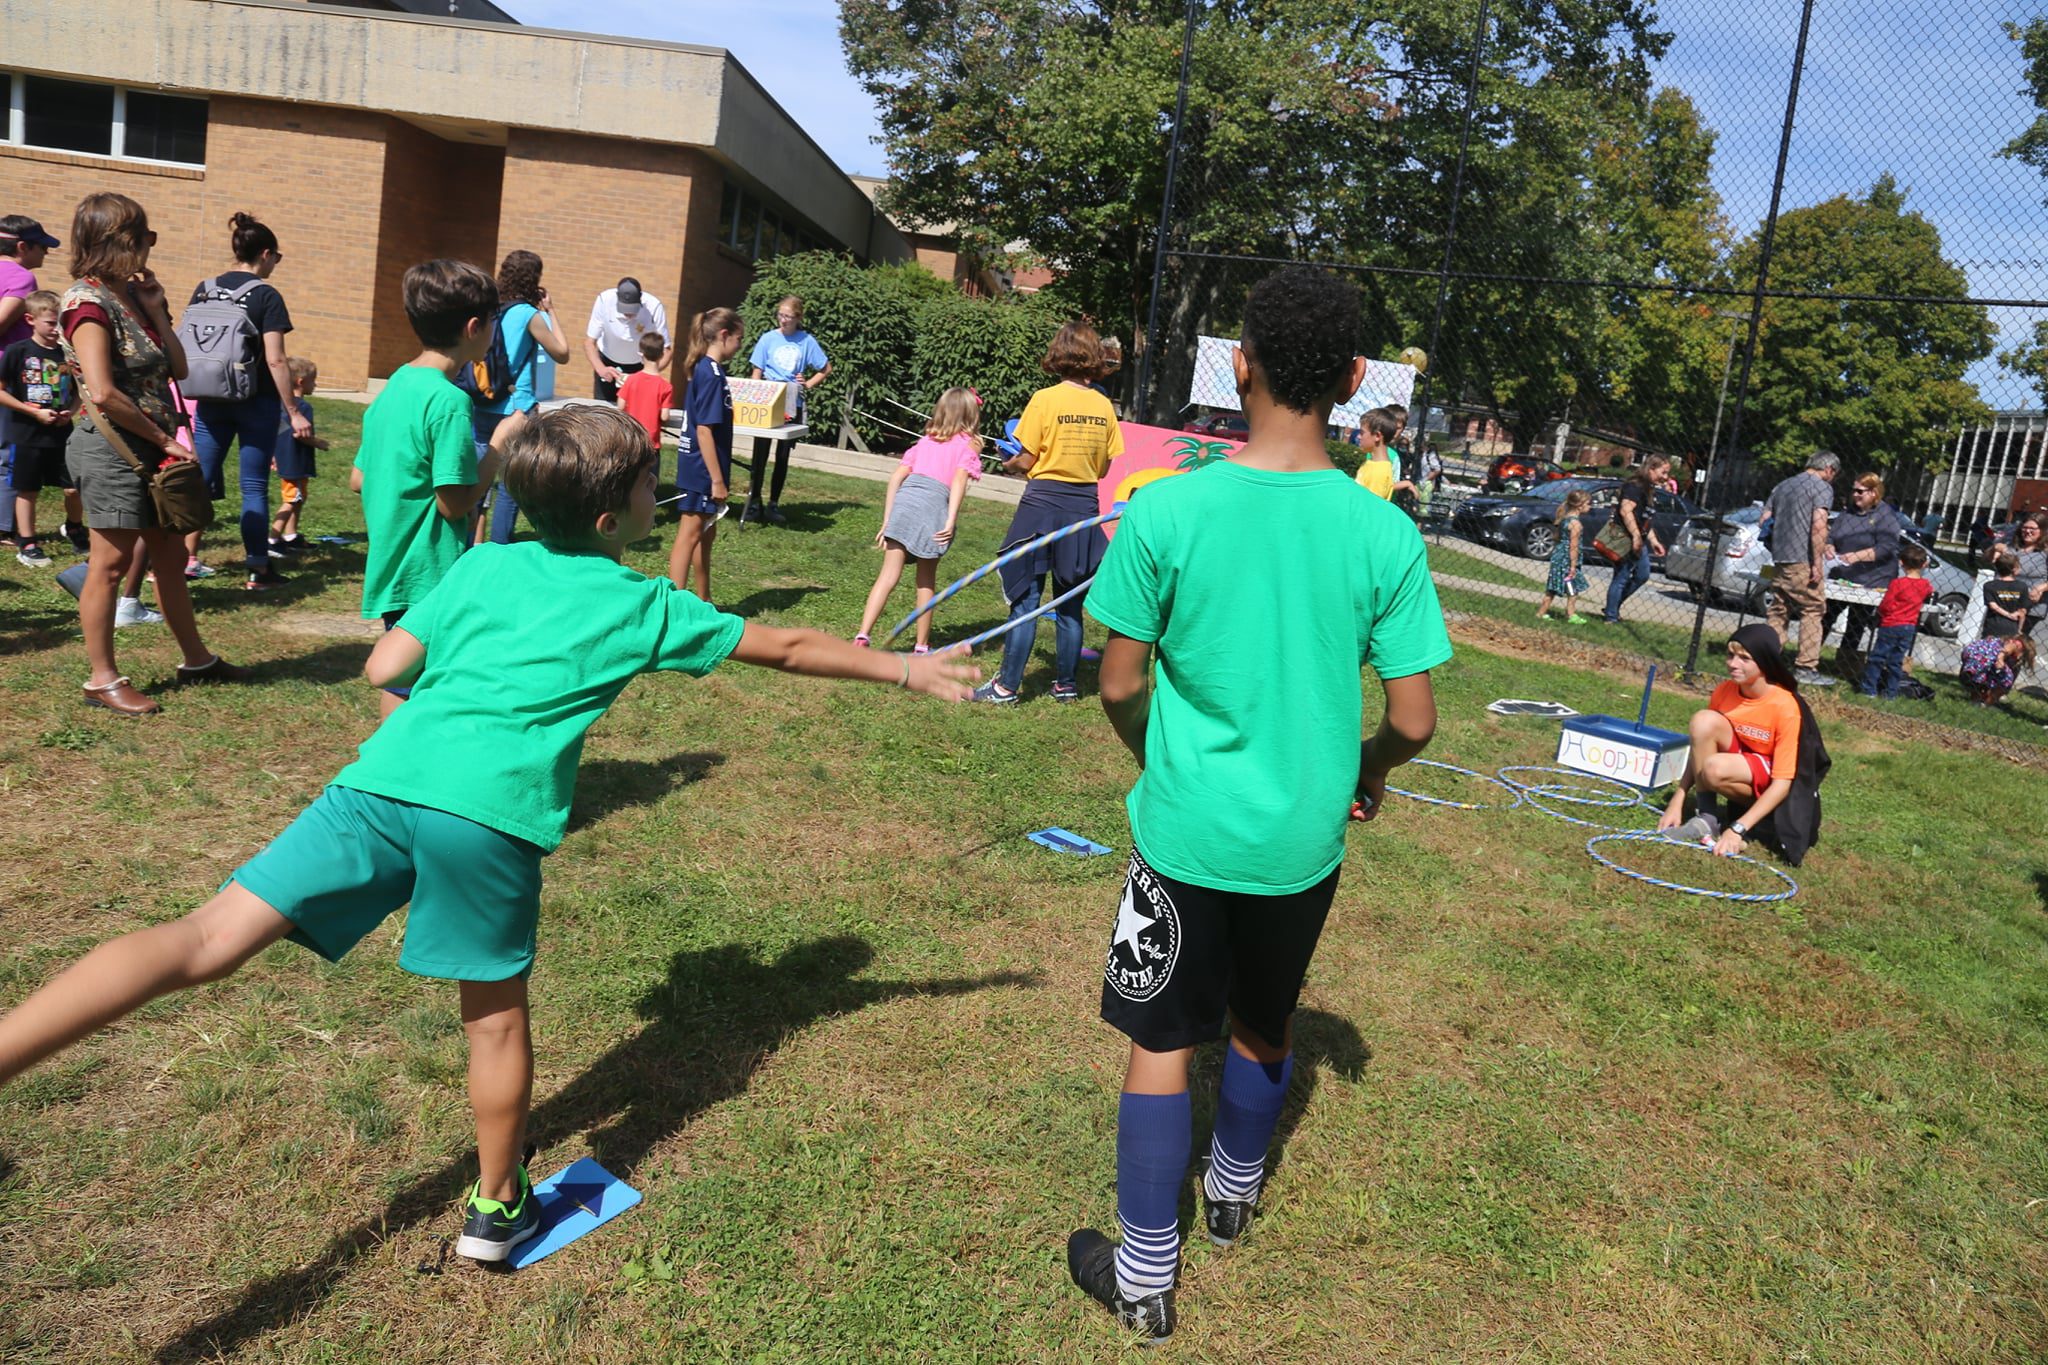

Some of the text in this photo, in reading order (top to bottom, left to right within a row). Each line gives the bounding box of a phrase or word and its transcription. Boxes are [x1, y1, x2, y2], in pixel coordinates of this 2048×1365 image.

[740, 406, 768, 425] POP
[1057, 414, 1108, 427] VOLUNTEE
[1735, 724, 1772, 741] AZERS
[1120, 965, 1154, 988] STAR
